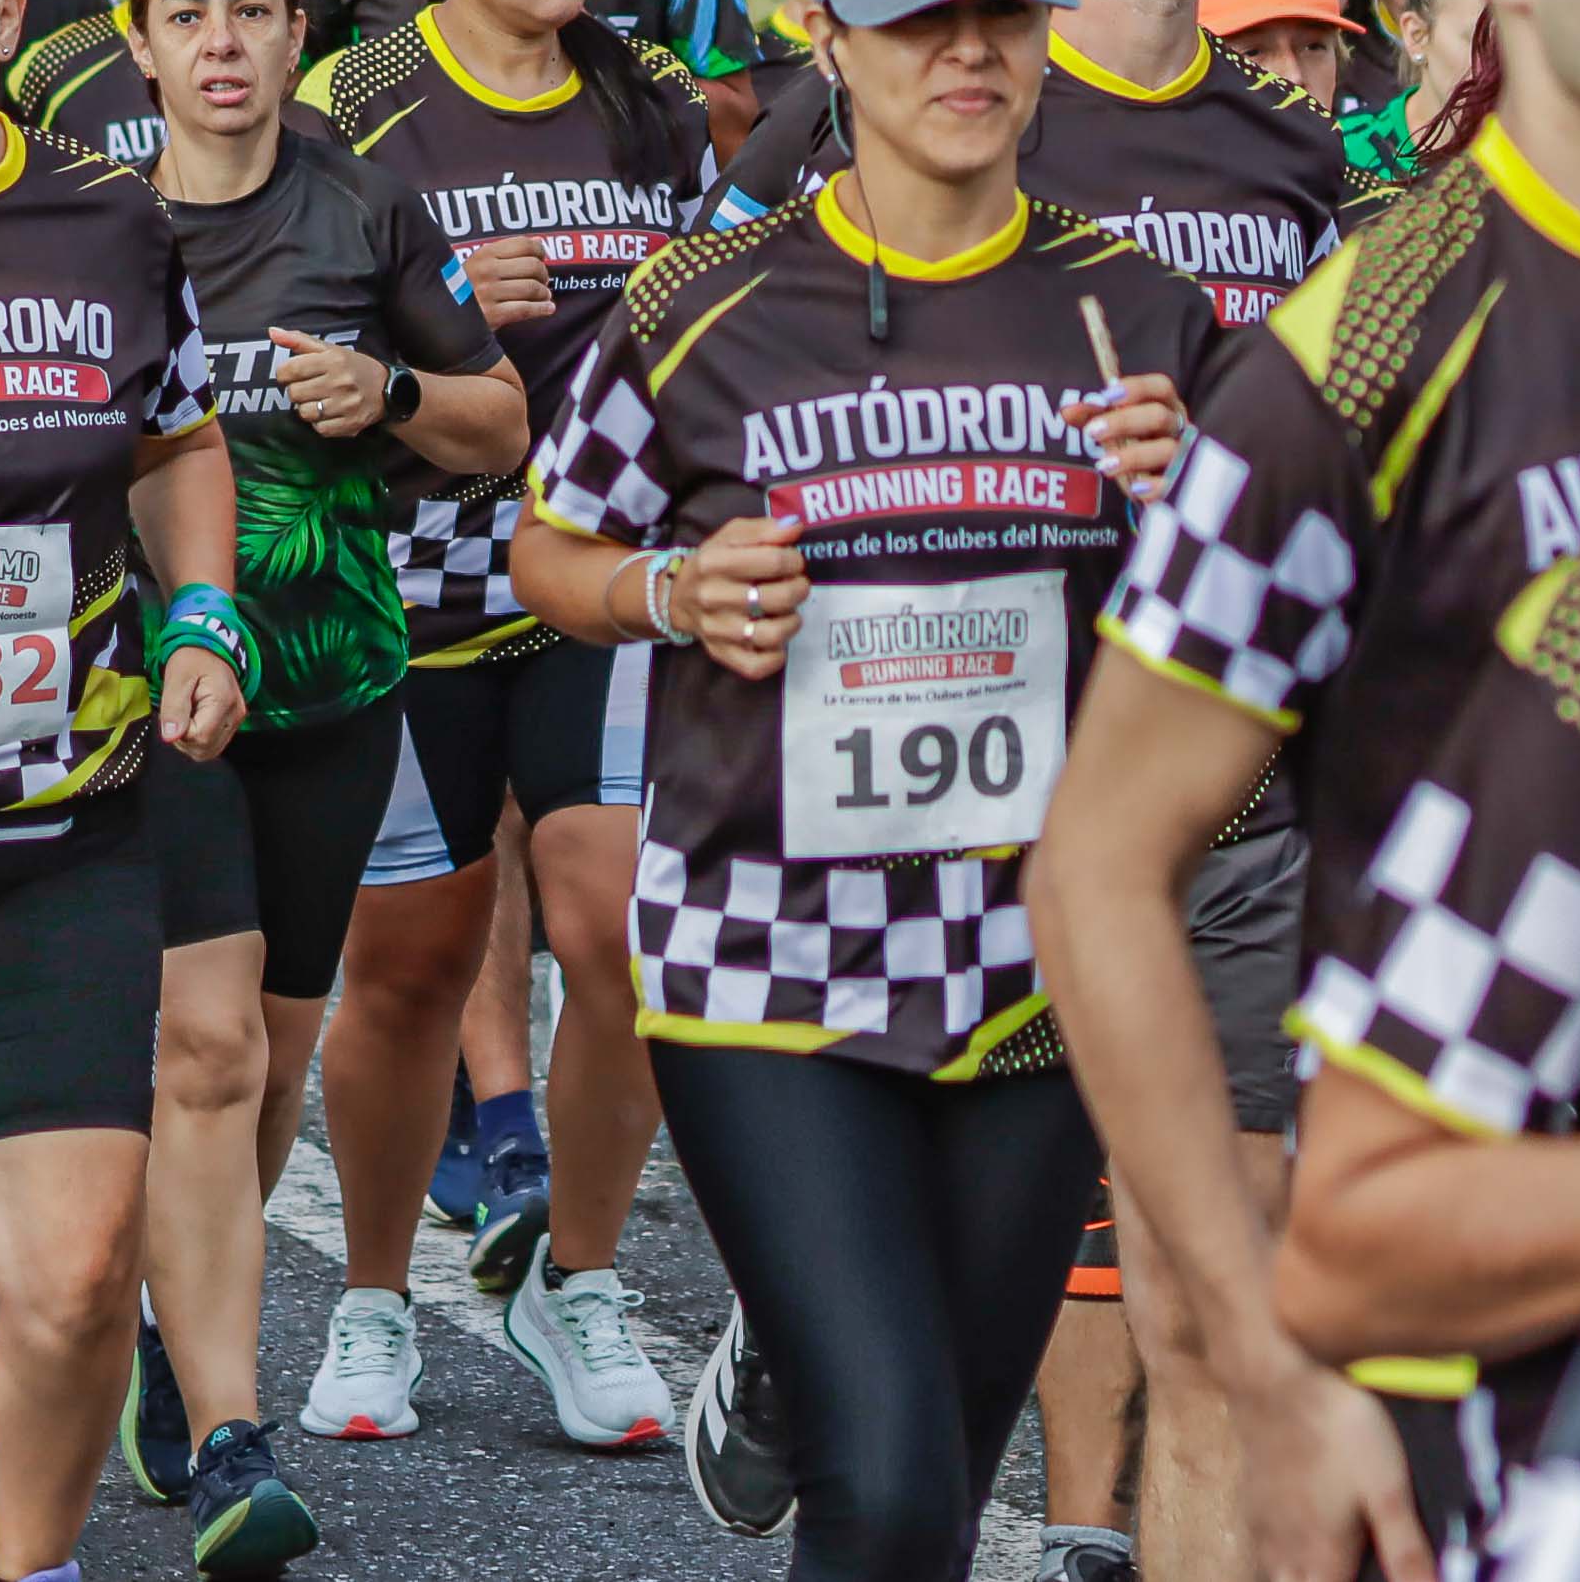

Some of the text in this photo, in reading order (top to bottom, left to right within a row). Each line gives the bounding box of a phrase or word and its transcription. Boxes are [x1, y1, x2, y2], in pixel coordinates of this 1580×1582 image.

[421, 172, 674, 237] UTÓDROMO
[581, 233, 649, 263] RACE
[601, 274, 627, 289] del
[1224, 287, 1287, 322] RAC
[3, 366, 80, 397] RACE
[34, 410, 61, 430] del
[64, 408, 127, 428] Noroeste
[801, 465, 1069, 524] RUNNING RACE
[853, 533, 881, 555] de
[886, 530, 919, 554] los
[923, 527, 998, 552] Clubes
[1004, 523, 1037, 548] del
[1041, 524, 1120, 548] Noroeste
[828, 604, 1029, 661] AUTÓDROMO
[860, 656, 949, 685] RUNNING
[835, 715, 1024, 809] 190
